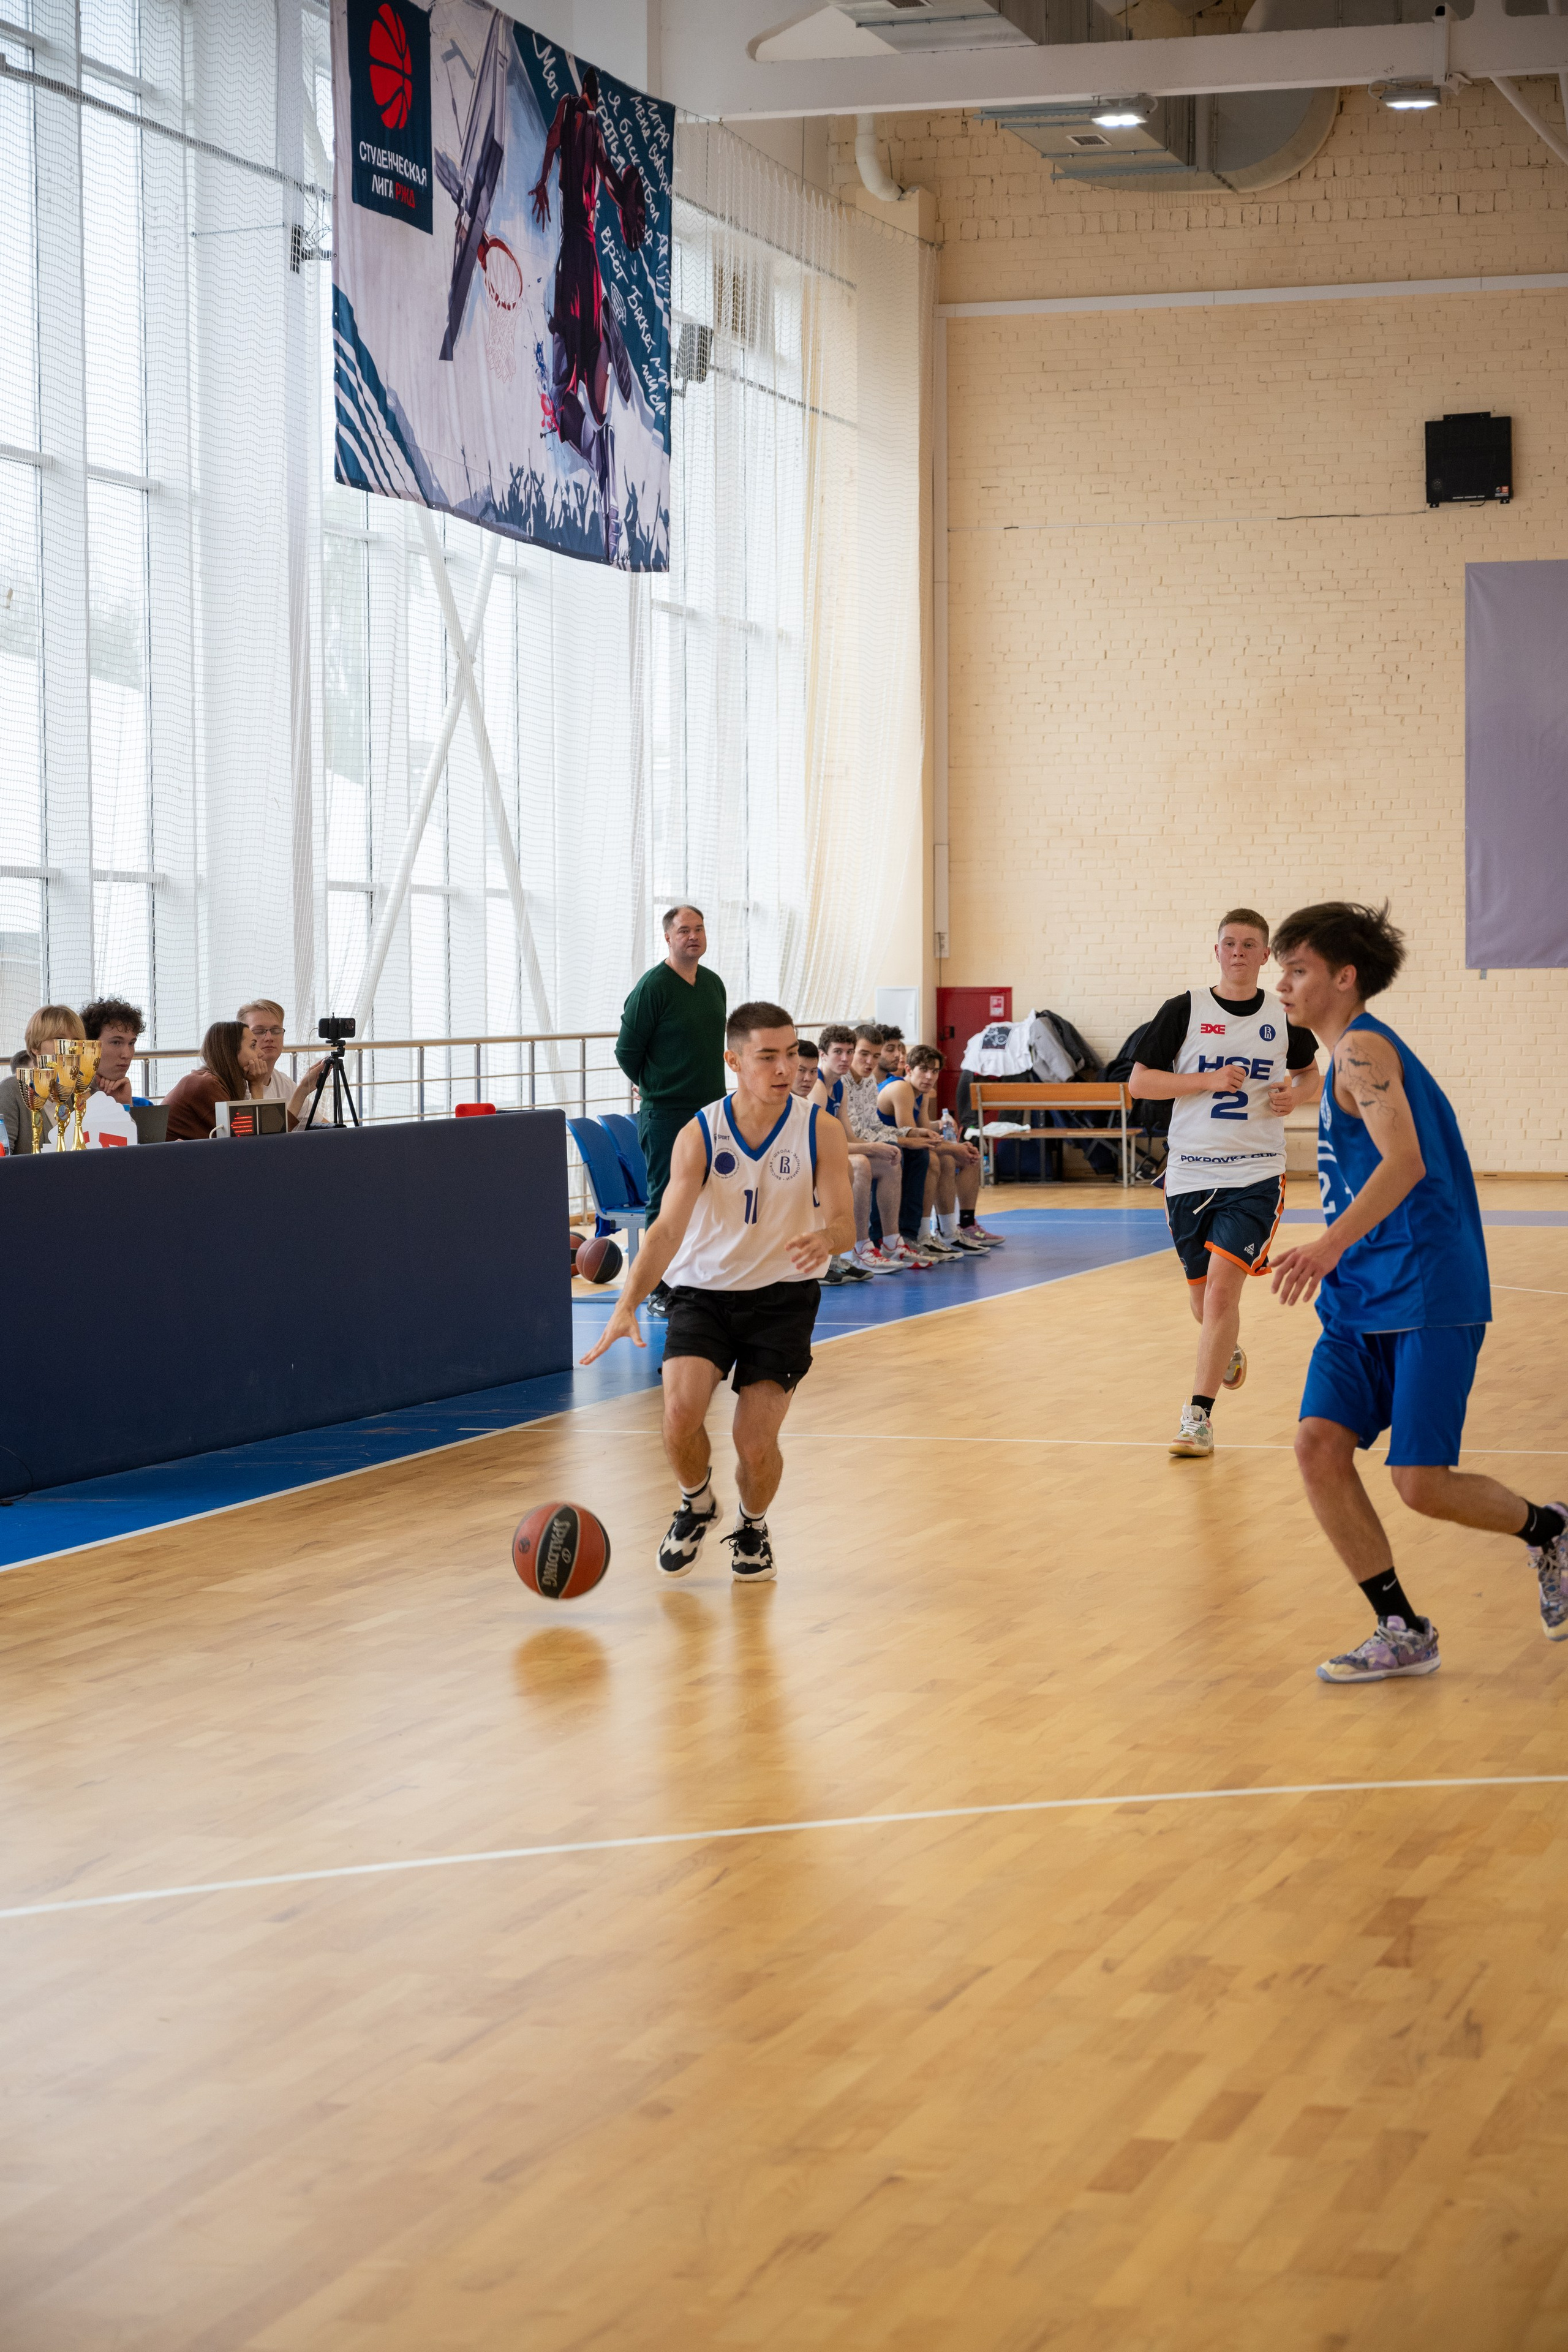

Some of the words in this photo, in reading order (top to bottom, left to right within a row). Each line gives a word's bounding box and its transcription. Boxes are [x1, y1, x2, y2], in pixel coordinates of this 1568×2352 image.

[359, 141, 428, 187] СТУДЕНЧЕСКАЯ
[371, 174, 394, 199] ЛИГА
[395, 182, 416, 208] РЖД
[1198, 1055, 1275, 1080] HSE
[1210, 1090, 1249, 1121] 2
[773, 1148, 791, 1158] ШКОЛА
[786, 1153, 801, 1181] ЭКОНОМИКИ
[744, 1186, 759, 1224] 11
[541, 1518, 571, 1588] SPALDING
